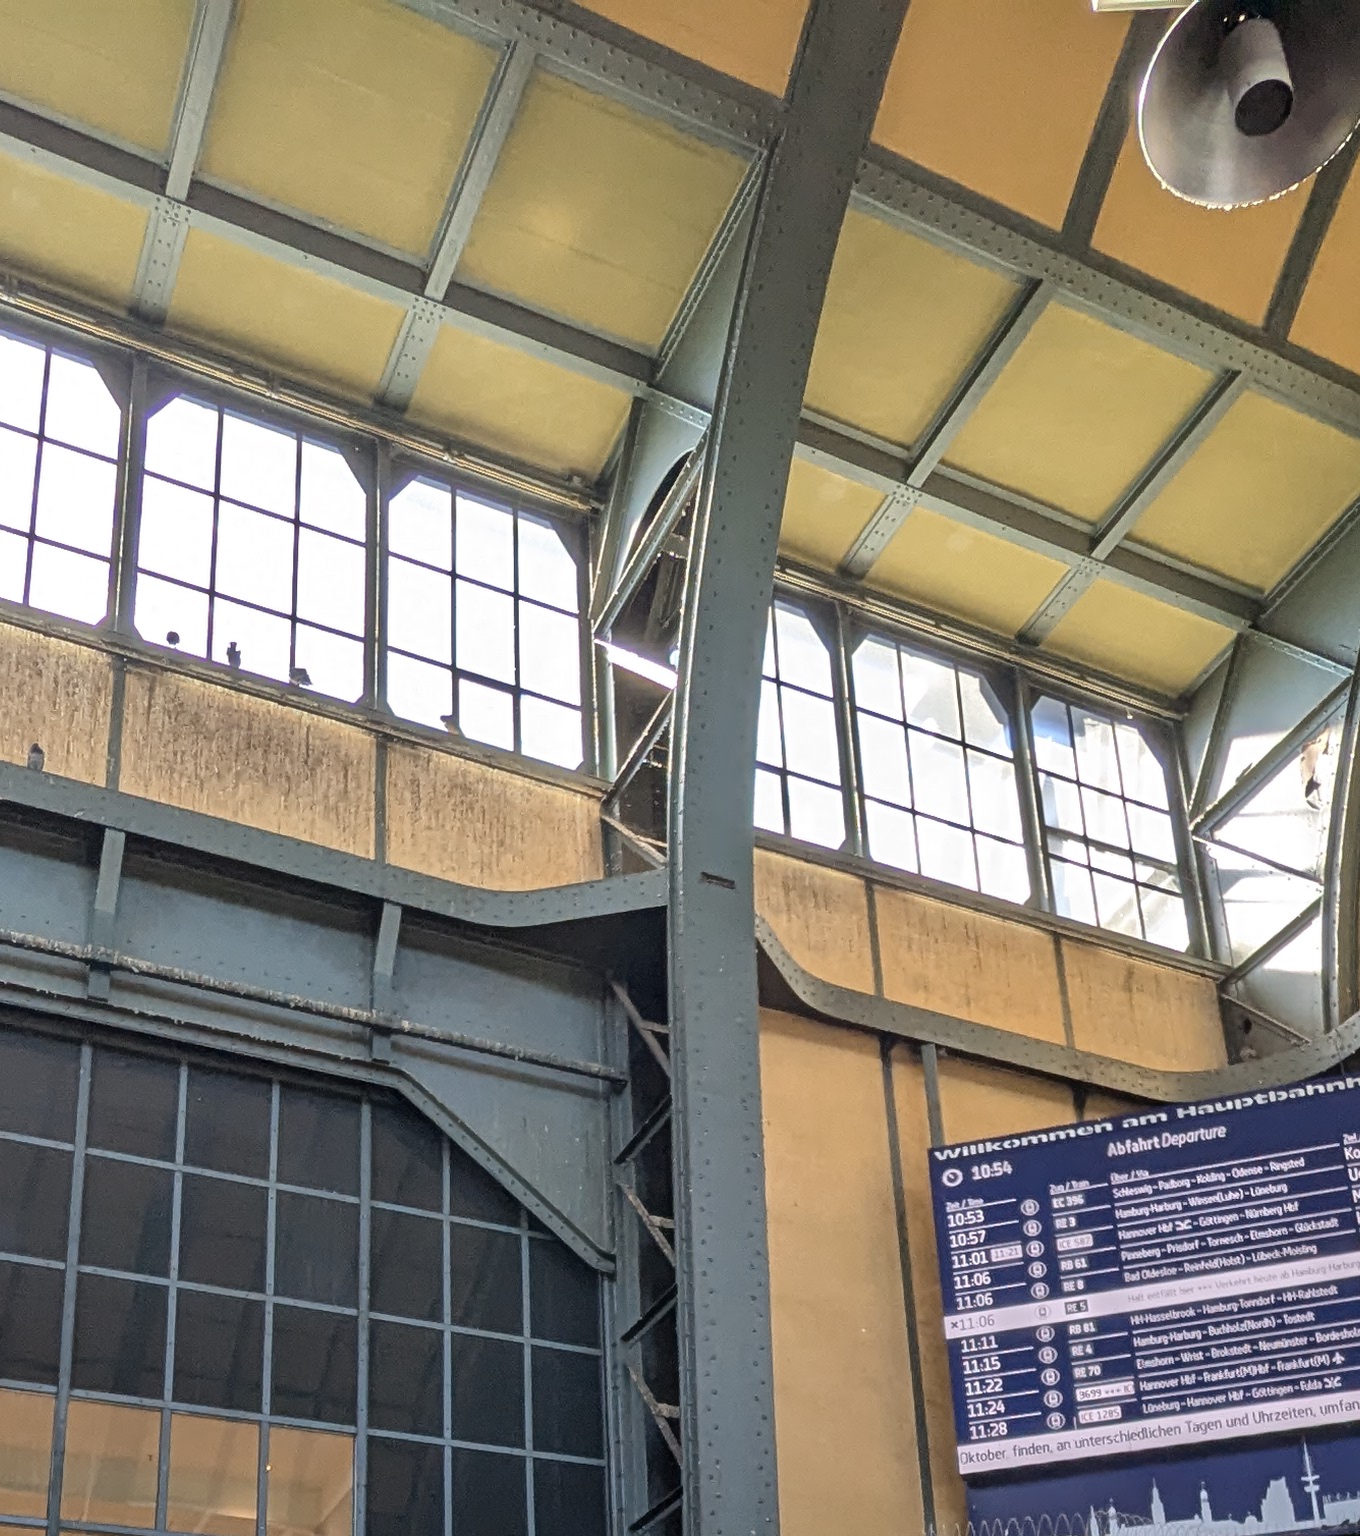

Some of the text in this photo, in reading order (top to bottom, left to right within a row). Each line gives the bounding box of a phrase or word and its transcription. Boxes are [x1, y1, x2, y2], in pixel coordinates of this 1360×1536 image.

[934, 1121, 1113, 1160] Willkommen
[1122, 1110, 1168, 1129] am
[1106, 1125, 1227, 1157] Abfahrt Departure
[971, 1161, 1013, 1181] 10:54
[947, 1210, 985, 1228] 10:53
[949, 1231, 986, 1248] 10:57
[952, 1251, 989, 1269] 11:01
[1075, 1258, 1087, 1269] 61
[953, 1272, 991, 1290] 11:06
[956, 1293, 994, 1311] 11:06
[1066, 1302, 1079, 1312] RE
[961, 1336, 998, 1353] 11:11
[963, 1357, 1001, 1375] 11:15
[1088, 1365, 1101, 1376] 70
[965, 1378, 1003, 1396] 11:22
[967, 1400, 1006, 1418] 11:24
[969, 1422, 1008, 1440] 11:28
[1057, 1440, 1072, 1450] an
[1074, 1424, 1181, 1450] unterschiedlichen
[1185, 1417, 1222, 1434] Tagen
[1226, 1413, 1249, 1427] und
[1253, 1403, 1317, 1425] Uhrzeiten,
